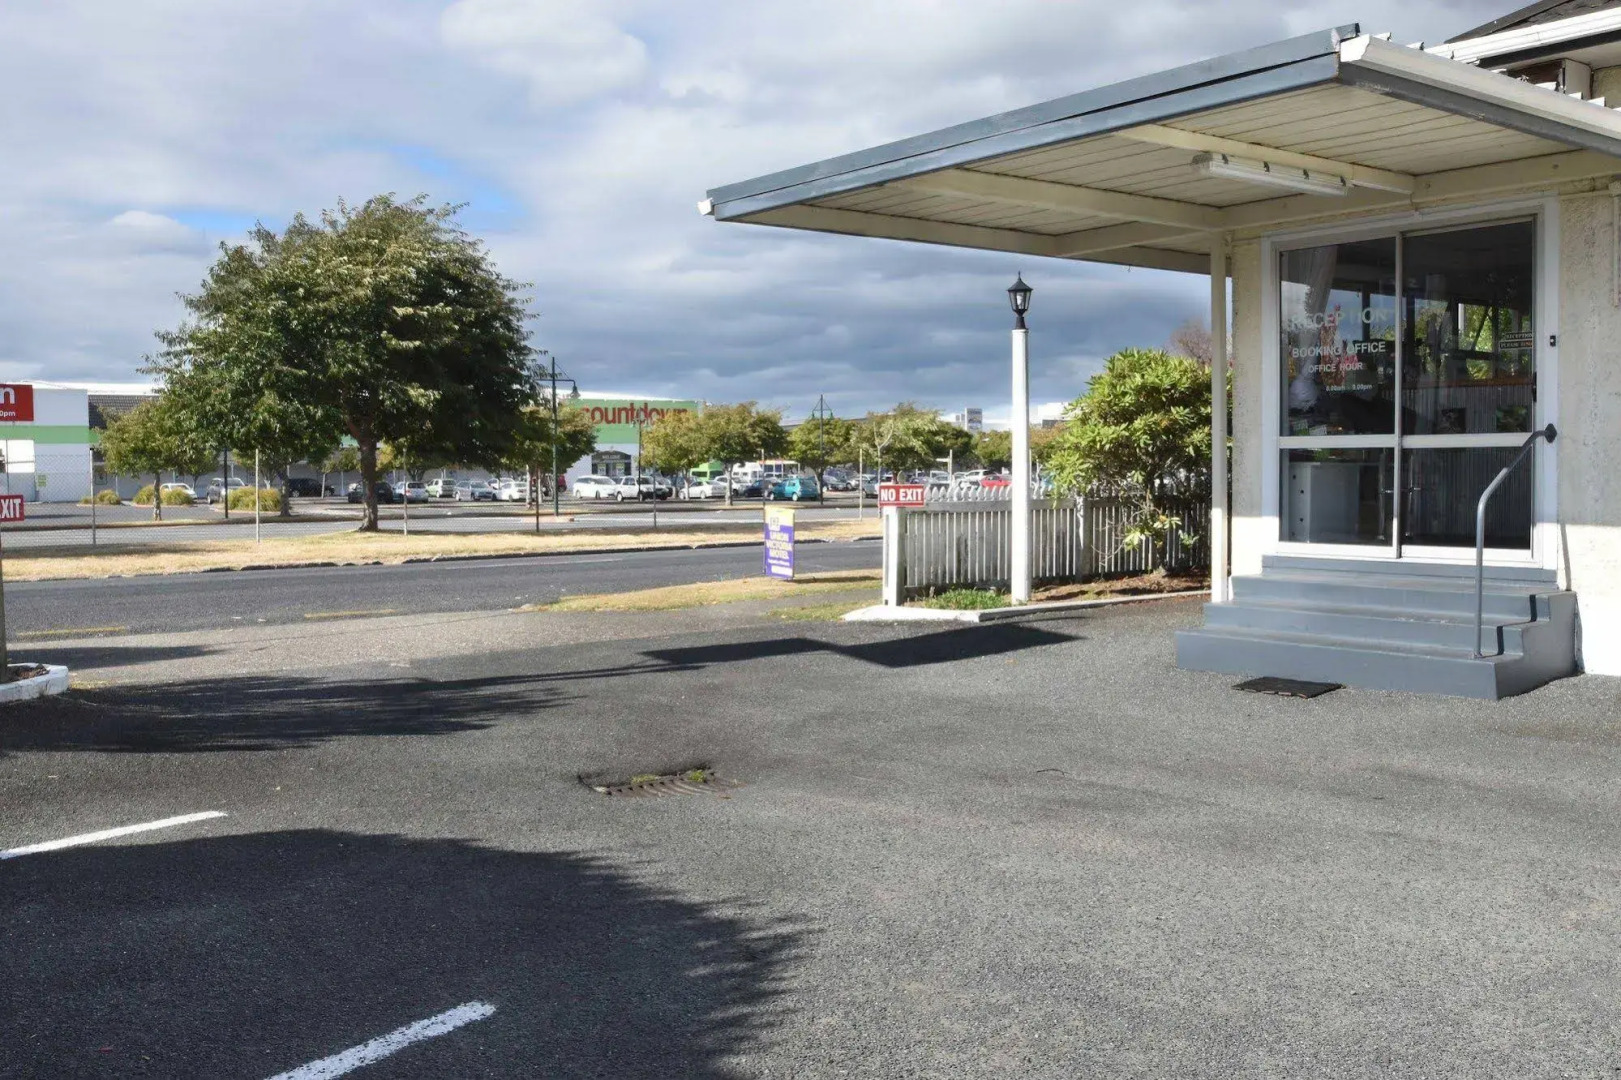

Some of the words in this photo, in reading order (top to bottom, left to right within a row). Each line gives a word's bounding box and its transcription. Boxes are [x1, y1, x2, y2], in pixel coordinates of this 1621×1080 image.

[1292, 345, 1342, 358] BOOKING
[1346, 341, 1386, 355] OFFICE
[1308, 364, 1337, 373] OFFICE
[881, 488, 896, 501] NO
[899, 488, 923, 501] EXIT
